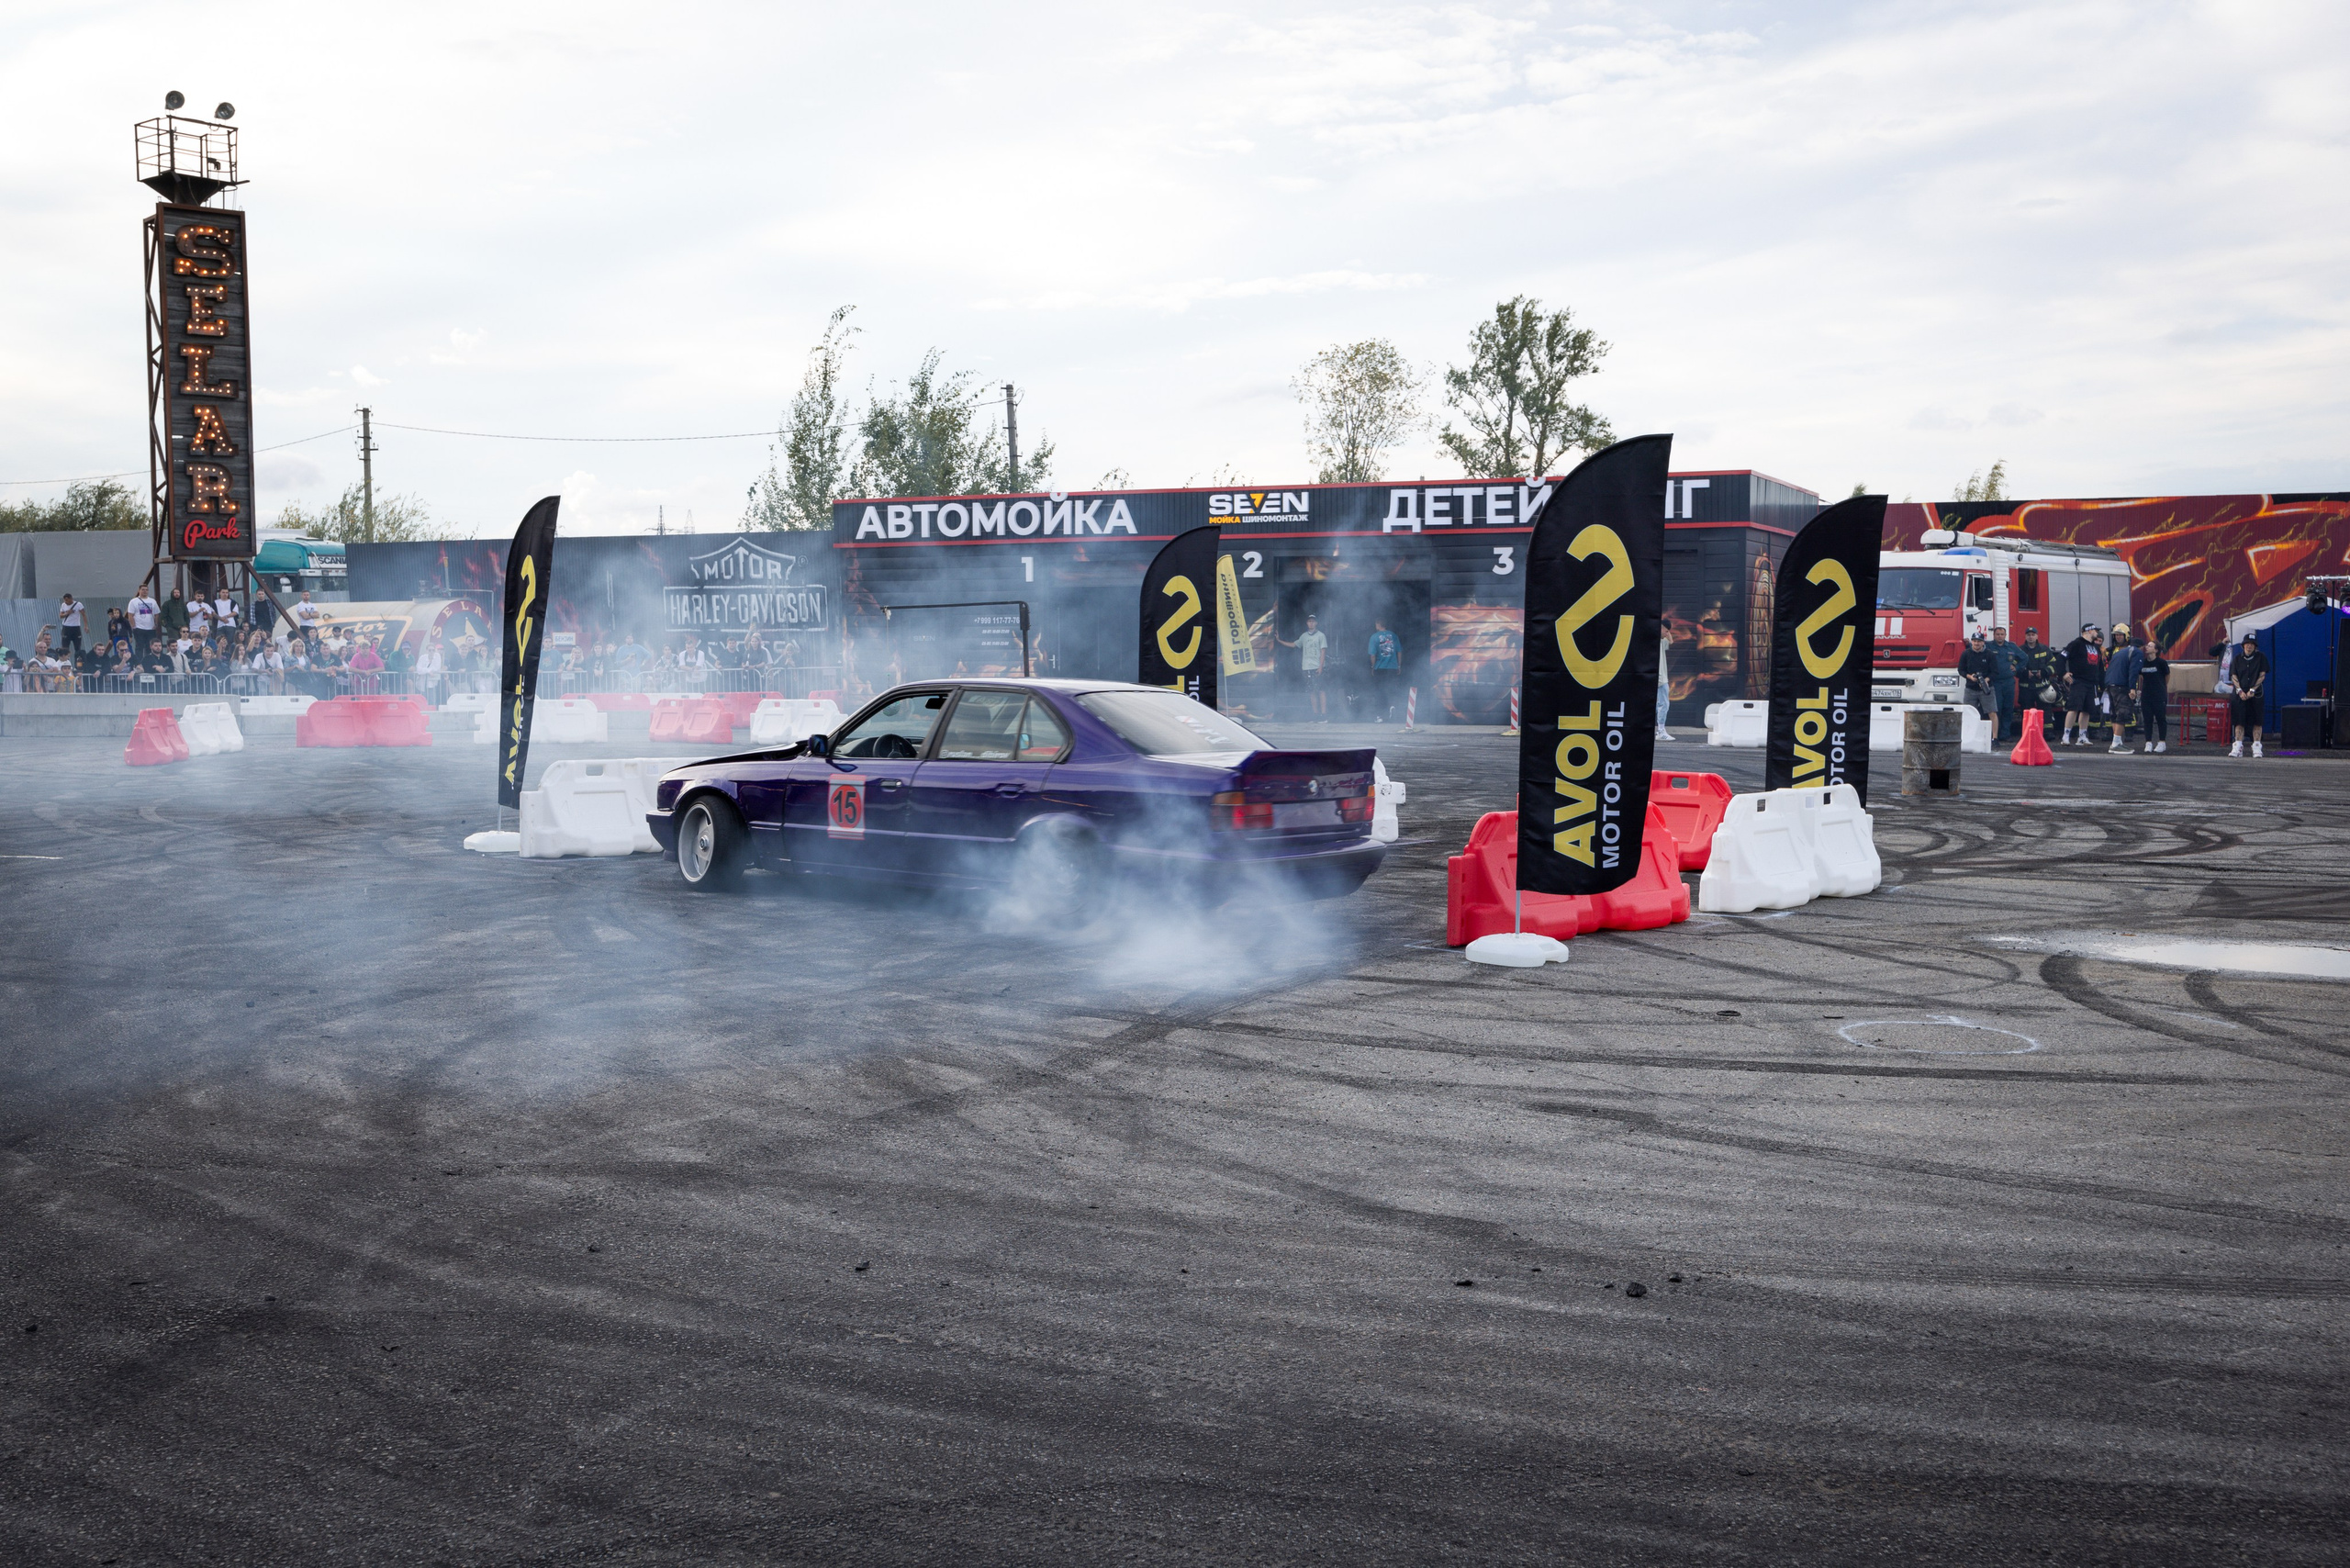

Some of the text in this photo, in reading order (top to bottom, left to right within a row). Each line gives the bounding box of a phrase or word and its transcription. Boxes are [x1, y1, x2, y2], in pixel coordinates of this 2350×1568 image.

[173, 224, 240, 515] SELAR
[856, 492, 1138, 540] АВТОМОЙКА
[1209, 514, 1309, 524] МОЙКА ШИНОМОНТАЖ
[185, 518, 241, 549] Park
[319, 555, 346, 565] SCANI
[704, 546, 782, 580] MOTOR
[1021, 556, 1035, 582] 1
[1242, 551, 1264, 578] 2
[1492, 546, 1515, 576] 3
[670, 592, 822, 625] HARLEY-DAVIDSON
[1832, 688, 1848, 725] OIL
[1553, 700, 1602, 868] AVOL
[1602, 701, 1625, 868] MOTOR OIL
[834, 790, 857, 823] 15
